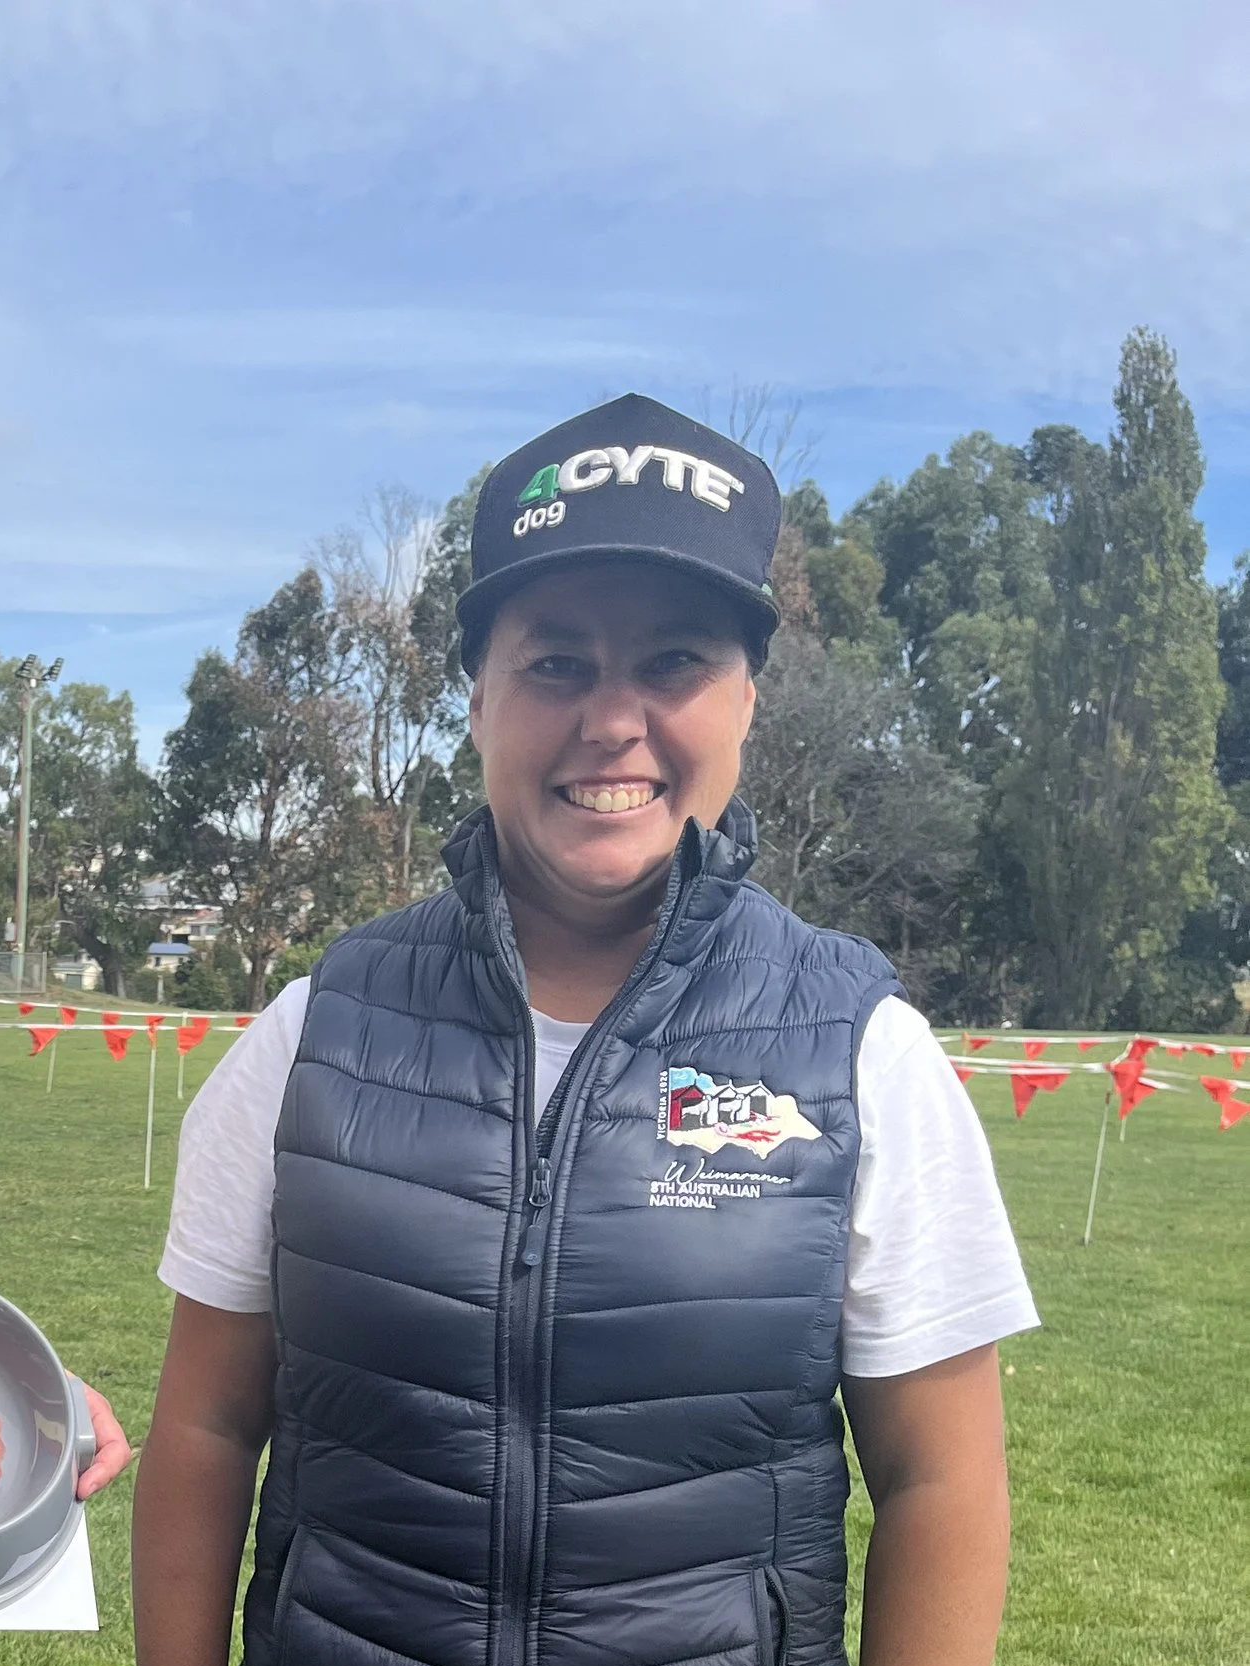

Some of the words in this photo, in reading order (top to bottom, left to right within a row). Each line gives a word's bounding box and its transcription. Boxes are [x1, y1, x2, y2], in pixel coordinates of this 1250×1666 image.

[515, 445, 732, 513] 4CYTE
[512, 500, 567, 538] dog
[656, 1096, 668, 1140] VICTORIA
[664, 1157, 792, 1186] Weimaraner
[649, 1194, 717, 1209] NATIONAL
[650, 1181, 676, 1194] 8TH
[677, 1182, 761, 1199] AUSTRALIAN
